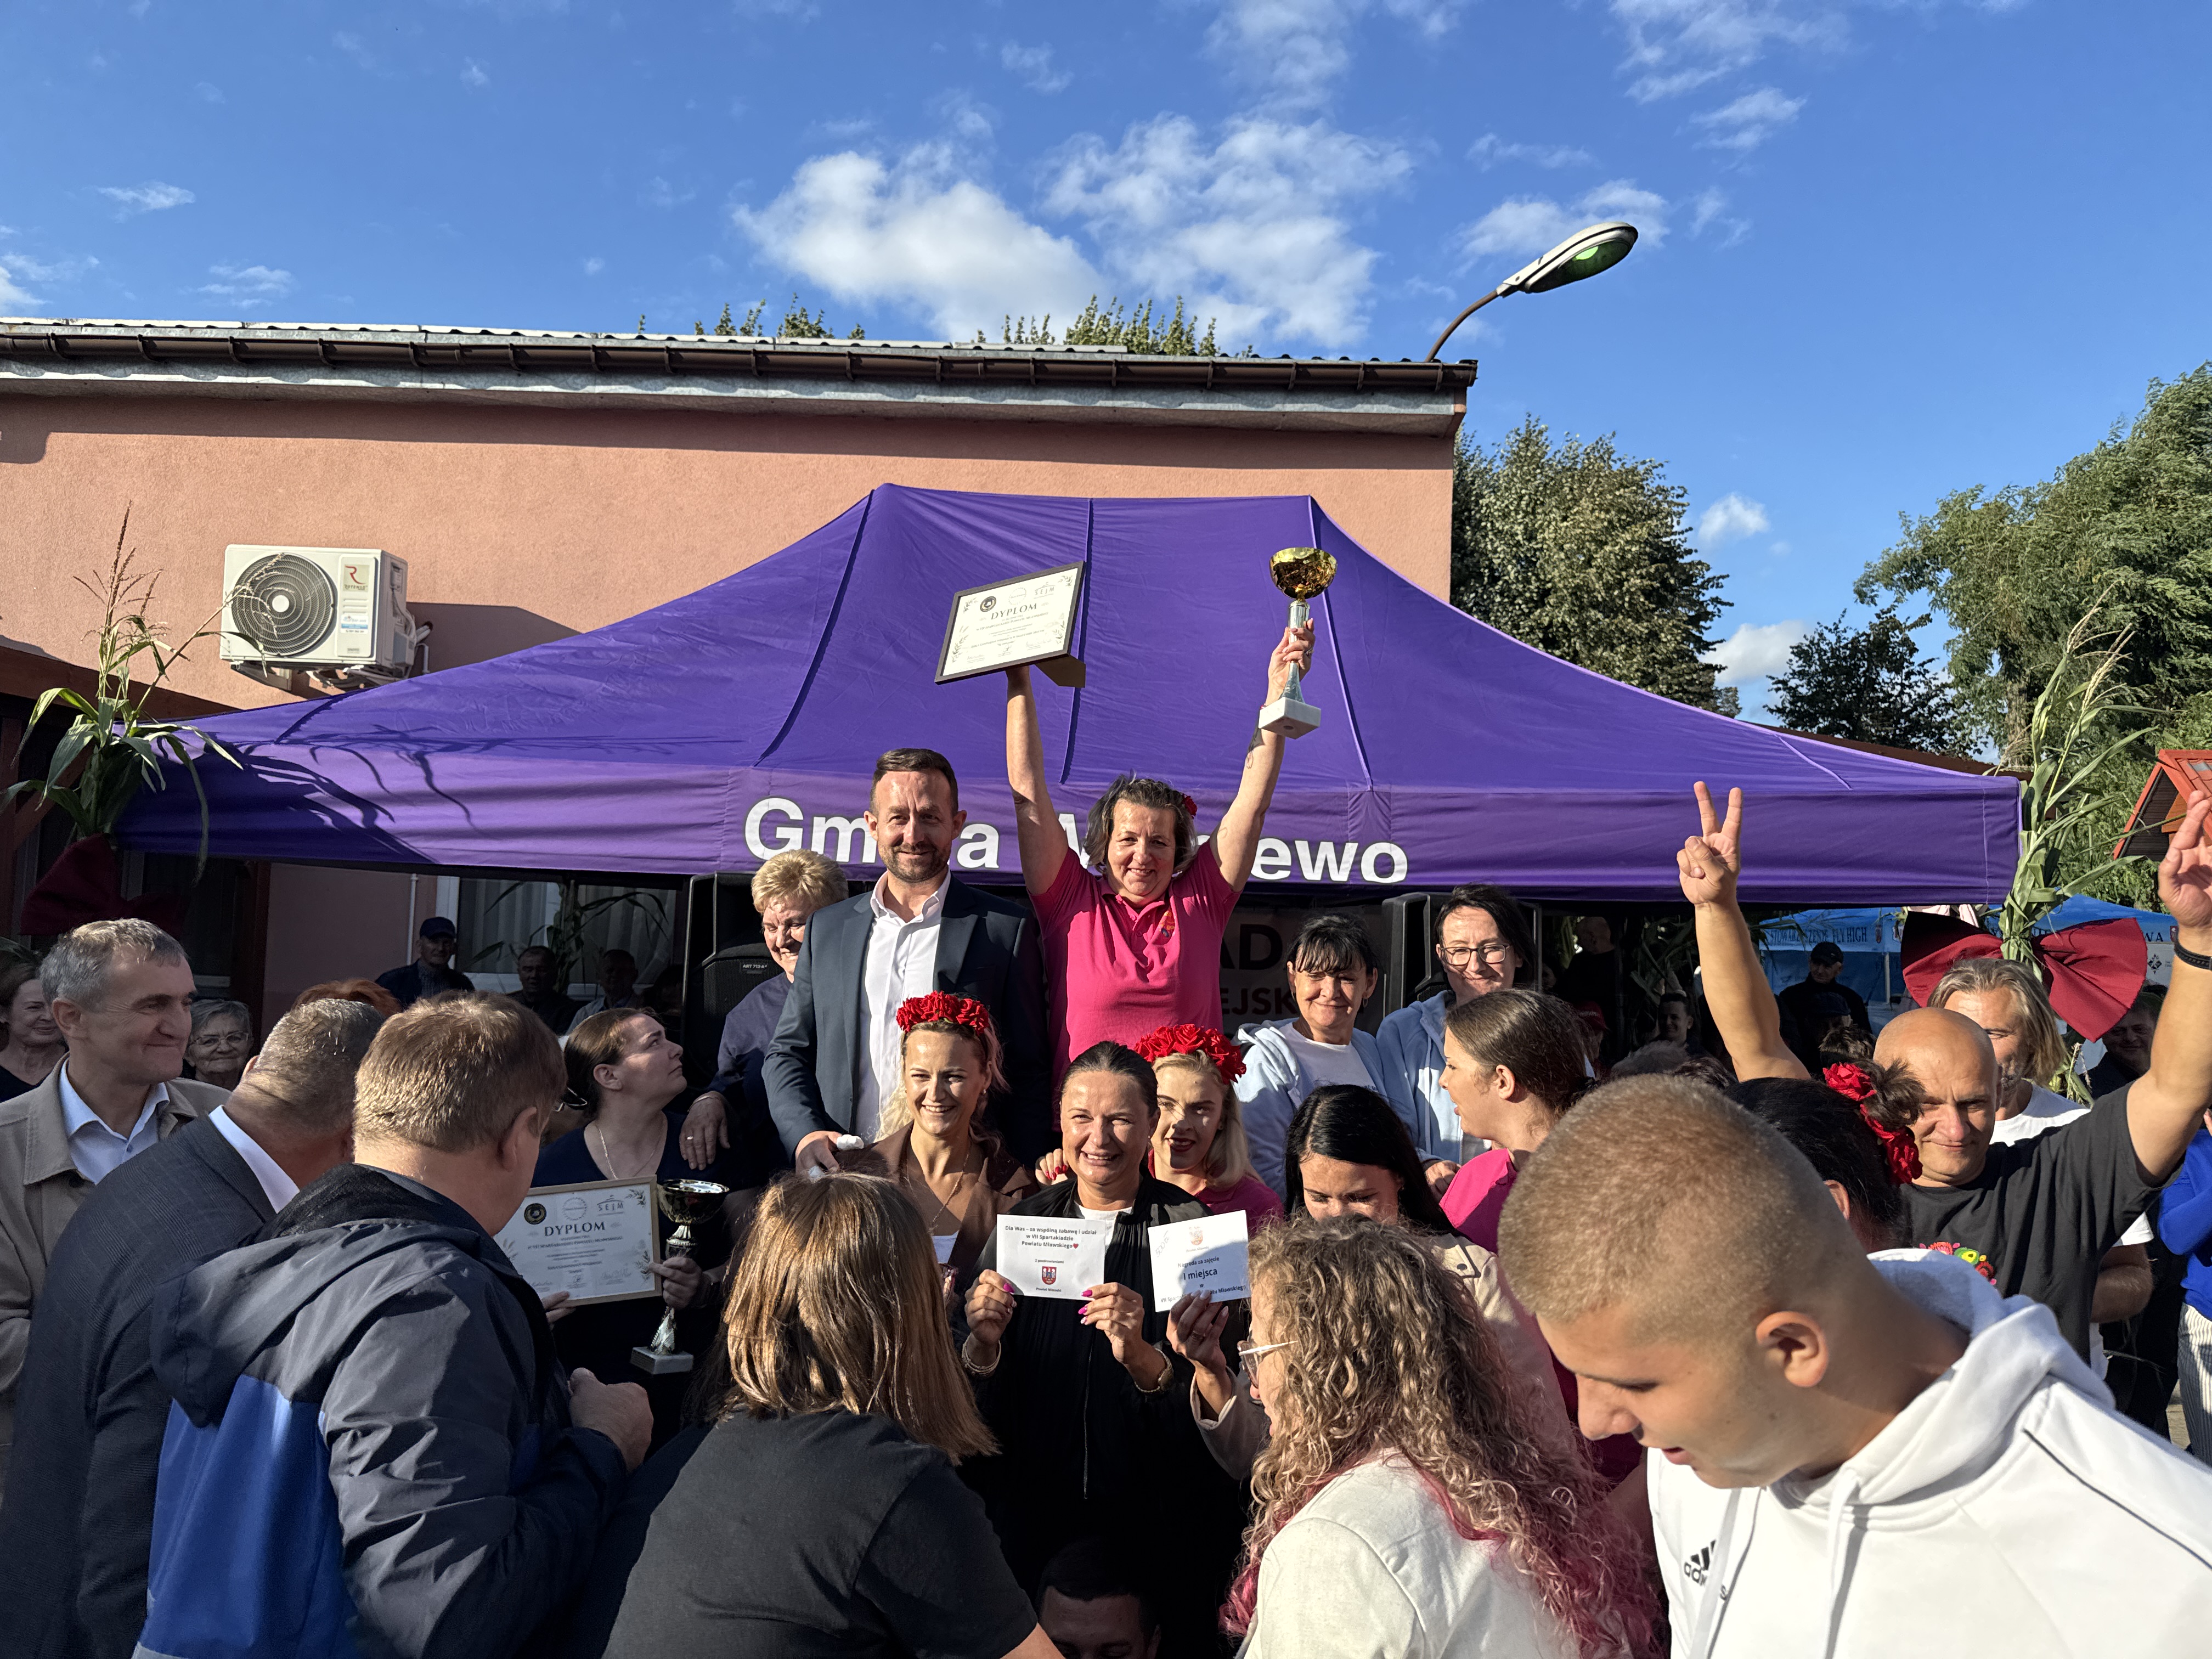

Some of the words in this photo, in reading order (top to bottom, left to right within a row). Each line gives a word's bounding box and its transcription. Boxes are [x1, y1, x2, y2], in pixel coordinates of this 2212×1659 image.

[1034, 586, 1054, 596] SEJM
[991, 603, 1037, 620] DYPLOM
[744, 797, 1000, 869] Gma
[1847, 927, 1867, 943] HIGH
[599, 1202, 624, 1211] SEJM
[544, 1222, 606, 1237] DYPLOM
[1188, 1268, 1218, 1280] miejsca
